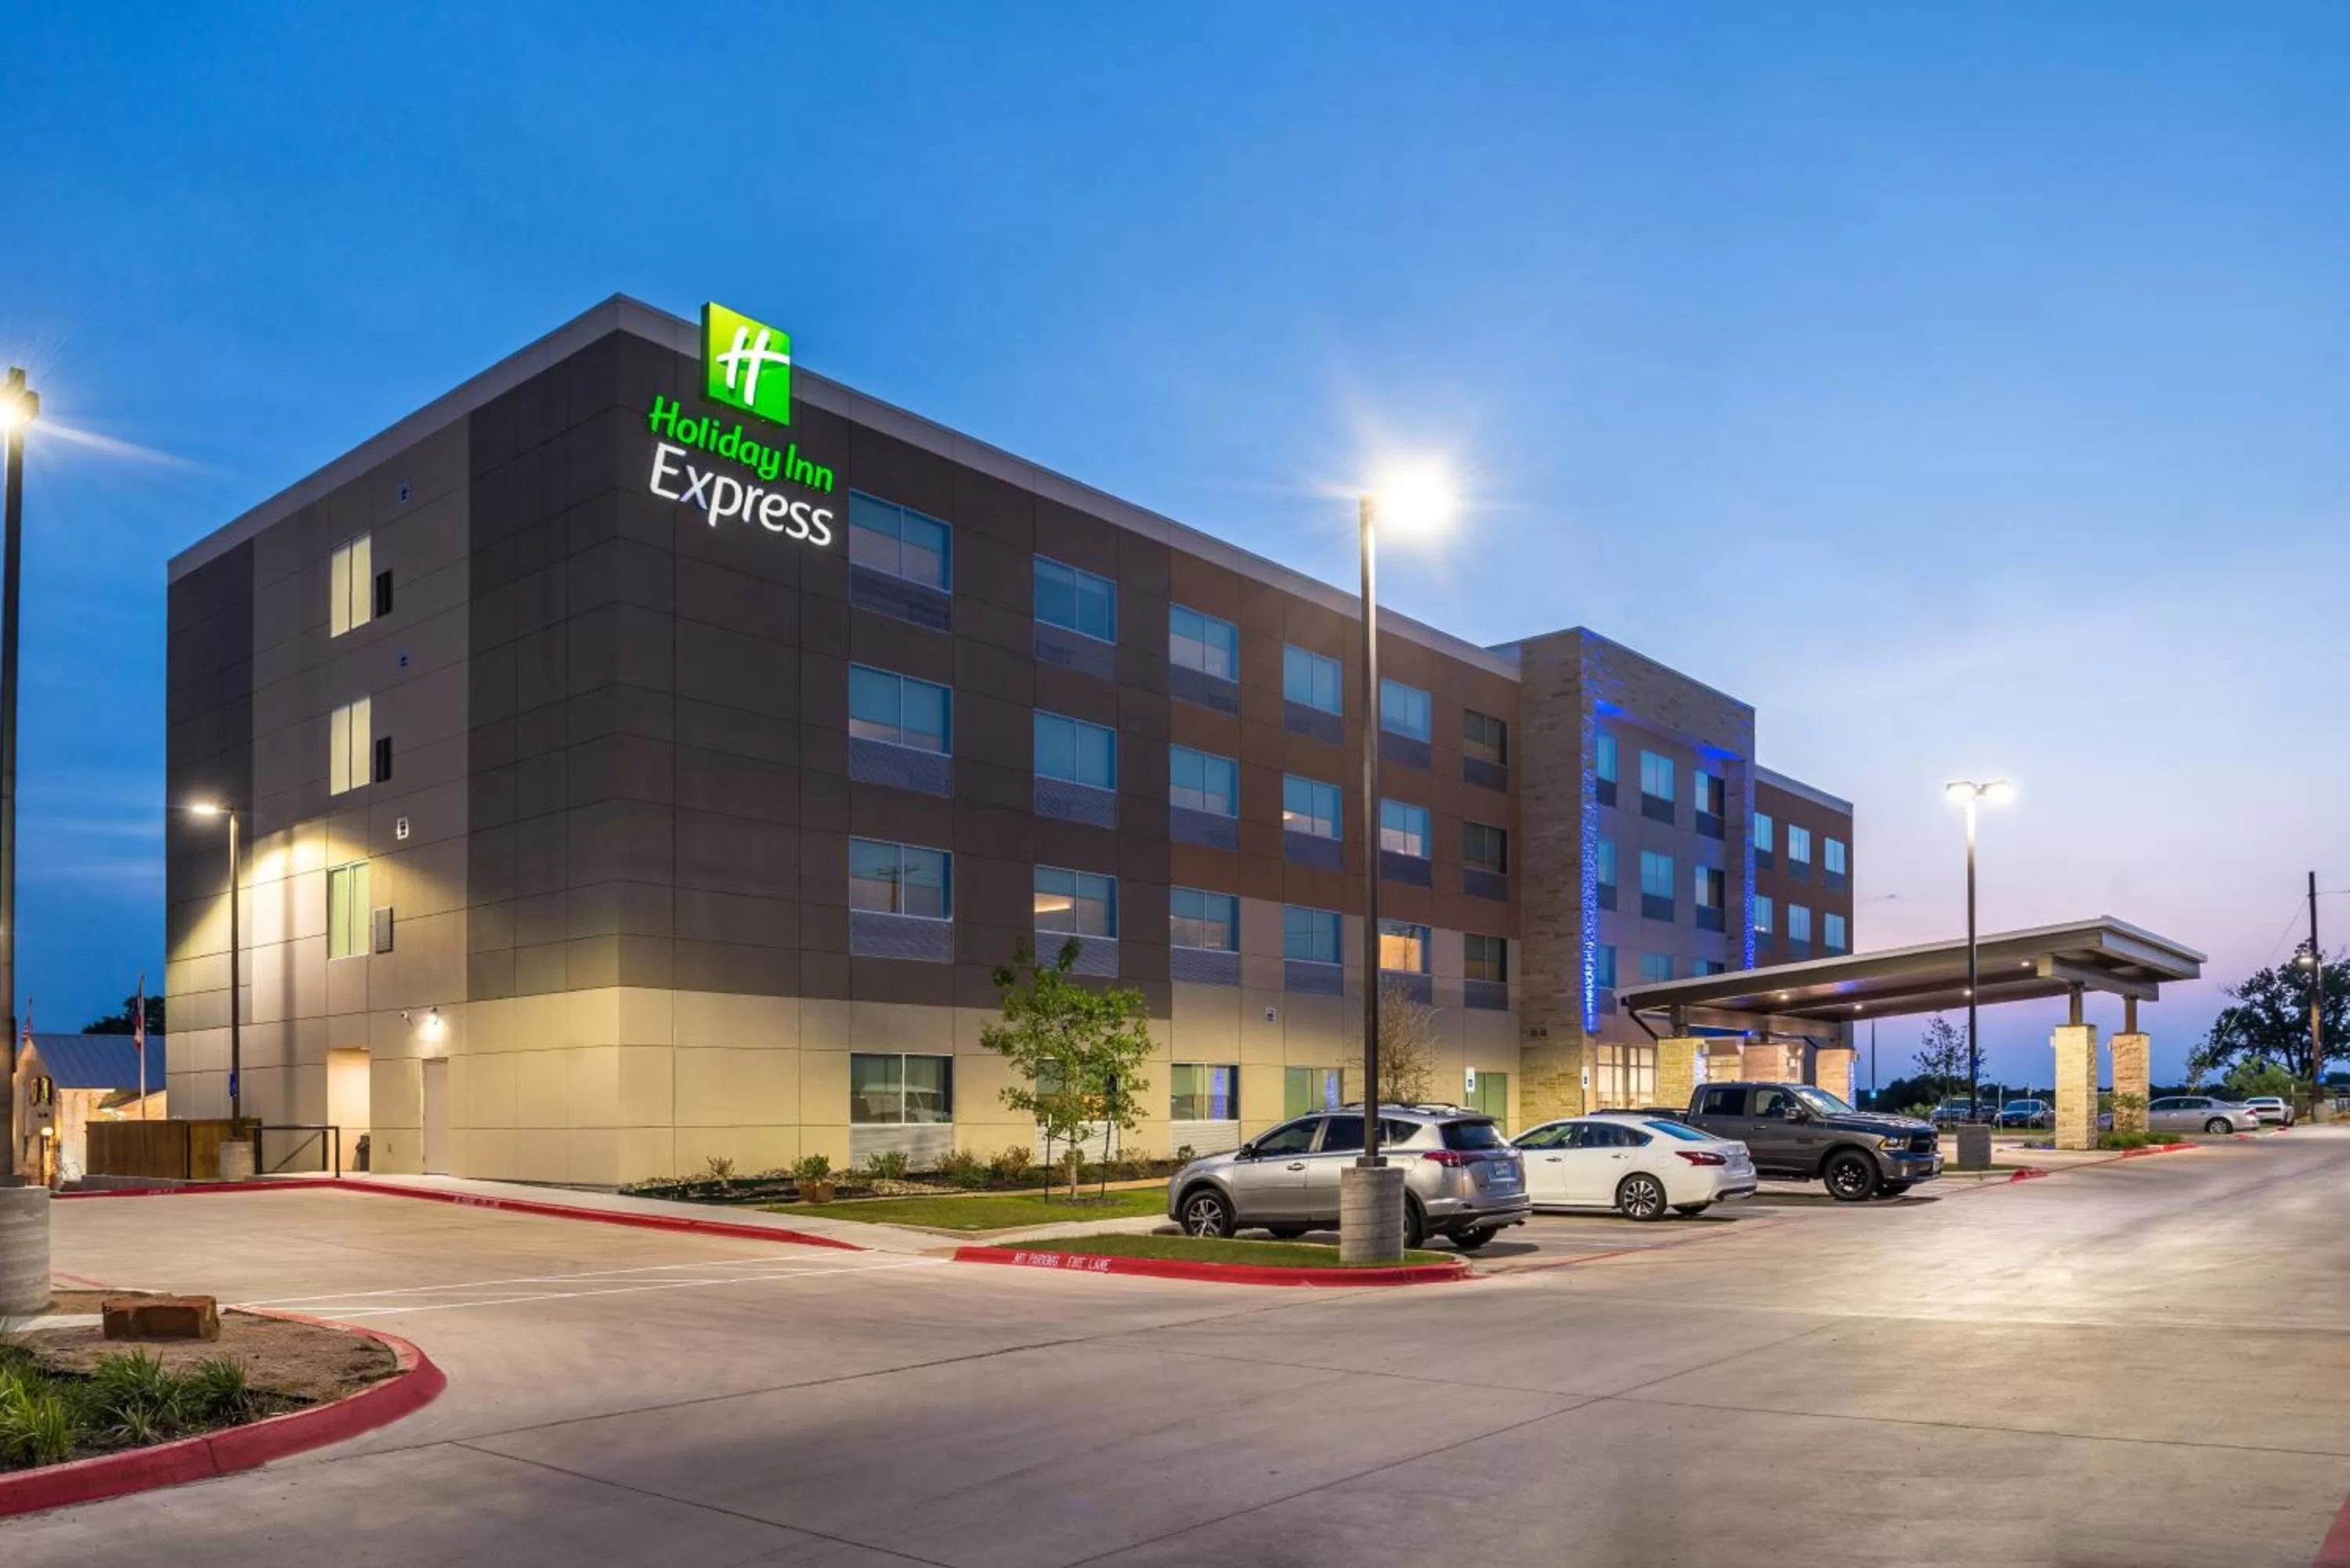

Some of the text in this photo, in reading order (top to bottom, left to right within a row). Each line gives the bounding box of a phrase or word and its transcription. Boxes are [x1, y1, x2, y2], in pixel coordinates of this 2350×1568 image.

[715, 325, 790, 407] H
[648, 394, 834, 494] Holiday Inn
[649, 441, 833, 547] Express
[1012, 1252, 1112, 1272] NO PARKING FIRE LANE
